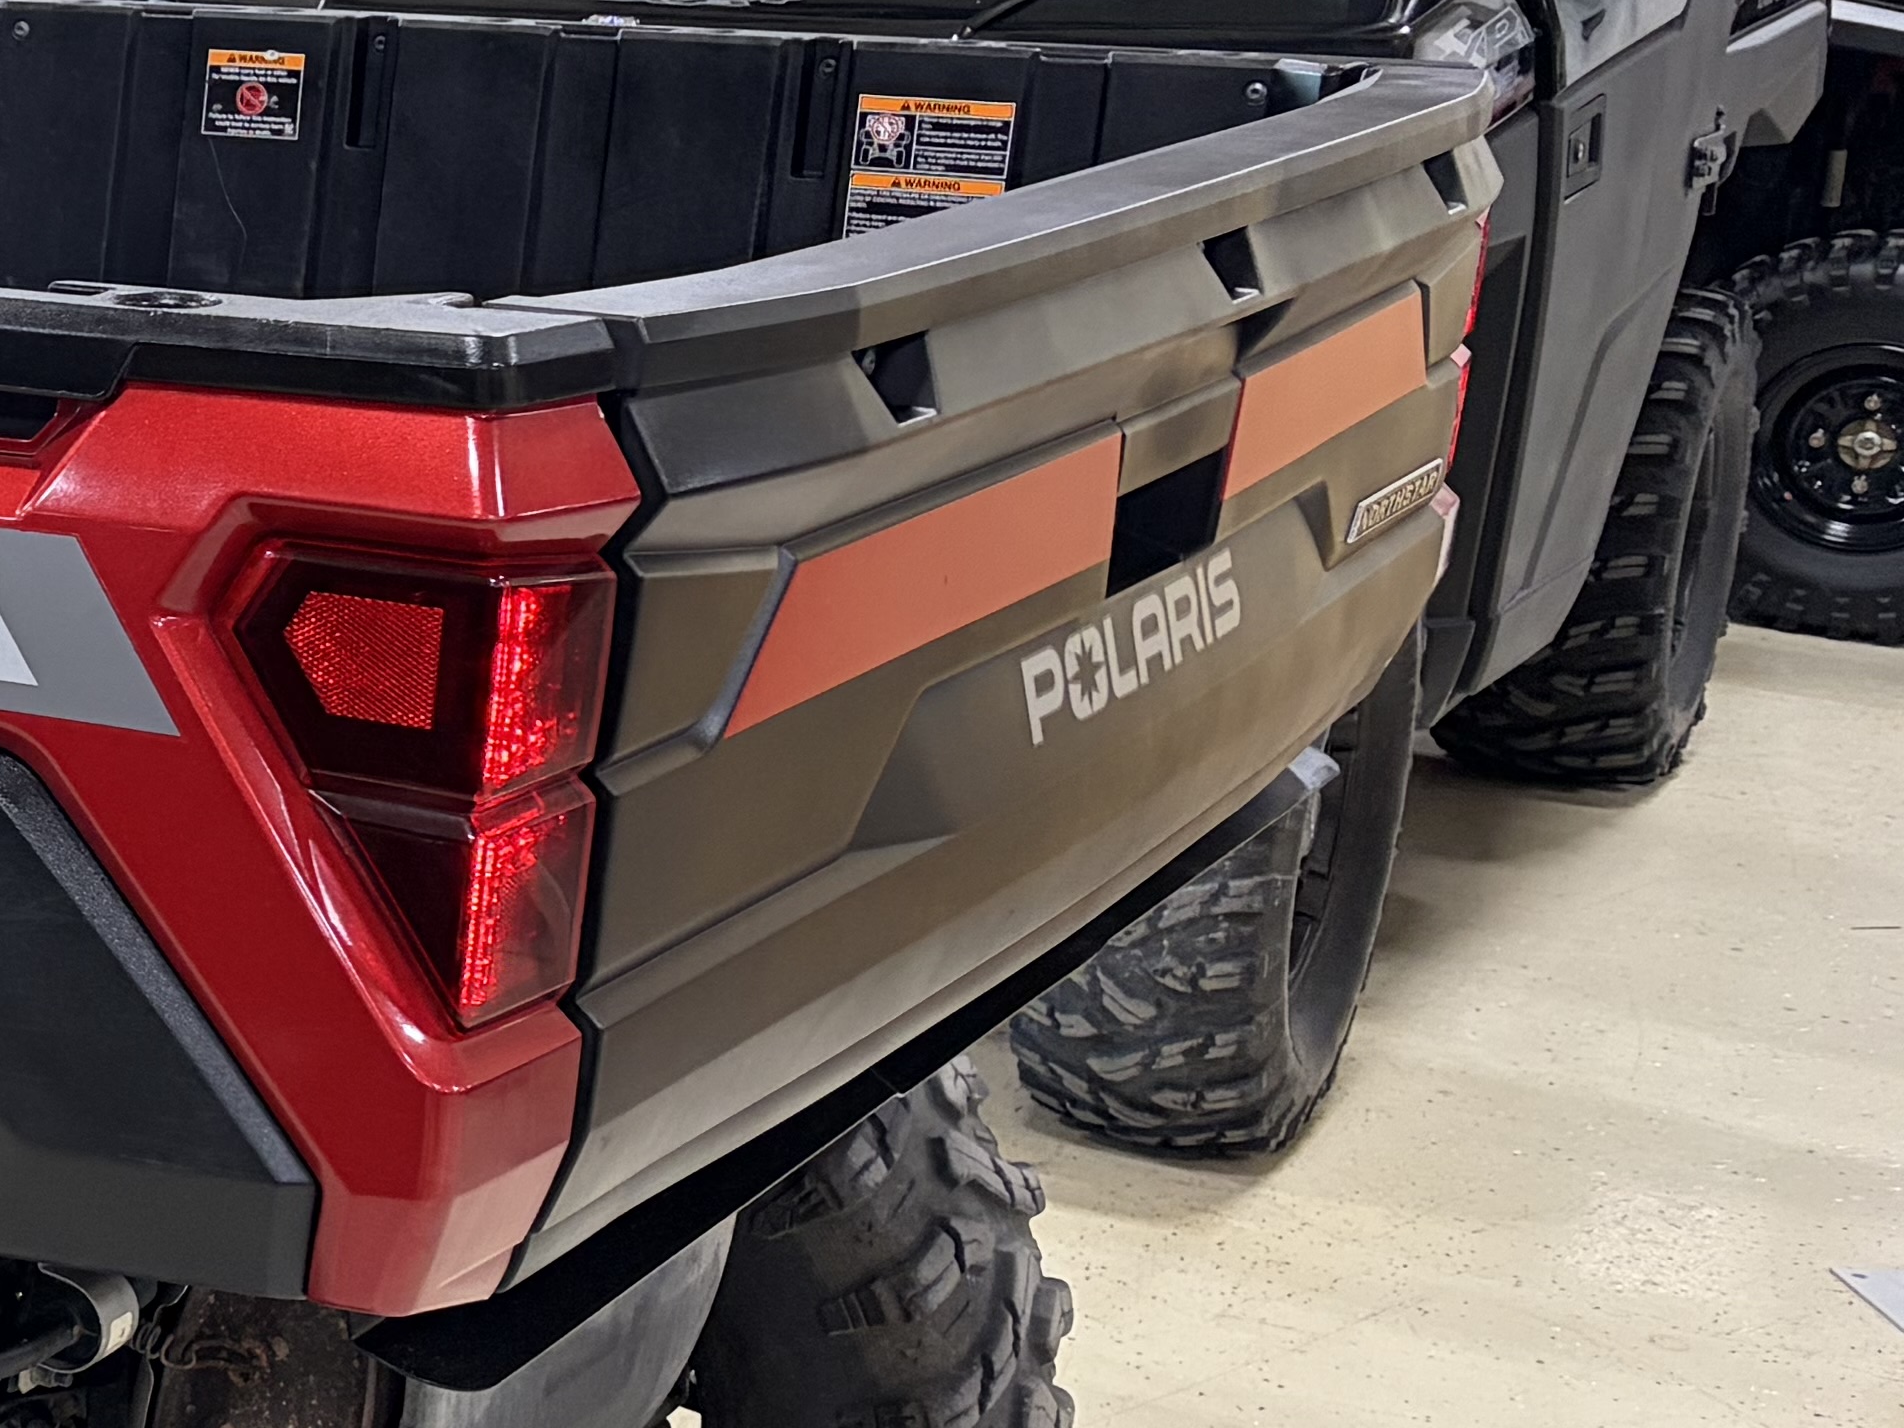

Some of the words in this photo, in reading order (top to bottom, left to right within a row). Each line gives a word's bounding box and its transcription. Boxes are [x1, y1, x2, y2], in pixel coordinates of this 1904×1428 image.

[914, 102, 971, 114] WARNING
[904, 179, 961, 192] WARNING
[1359, 465, 1442, 533] NORTHSTAR
[1020, 547, 1241, 746] POLARIS
